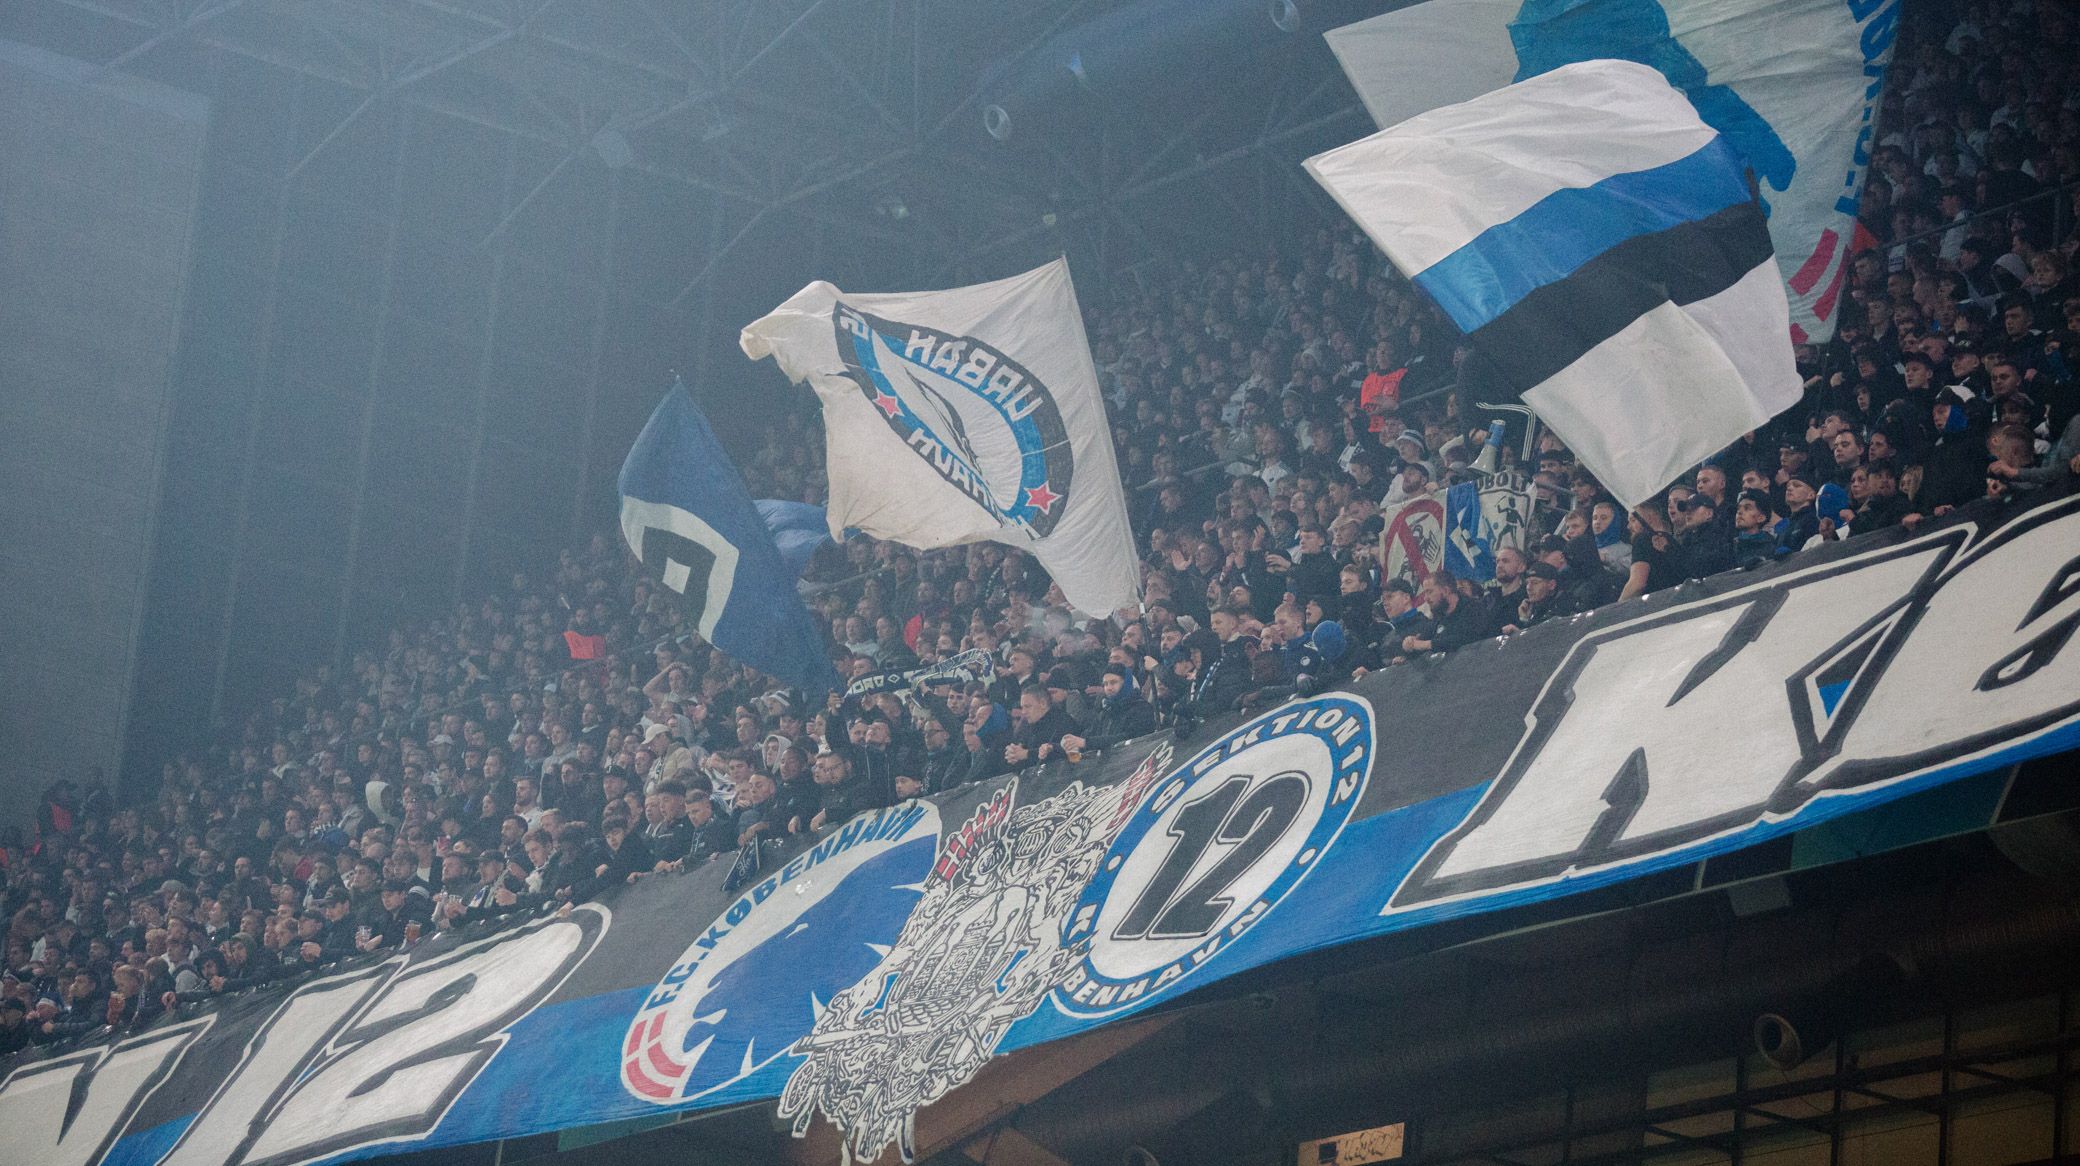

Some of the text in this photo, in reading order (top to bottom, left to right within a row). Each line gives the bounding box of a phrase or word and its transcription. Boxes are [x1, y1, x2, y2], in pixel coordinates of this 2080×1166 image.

[1152, 708, 1360, 812] SEKTION
[1112, 770, 1312, 940] 12
[1067, 900, 1269, 1006] KBENHAVN
